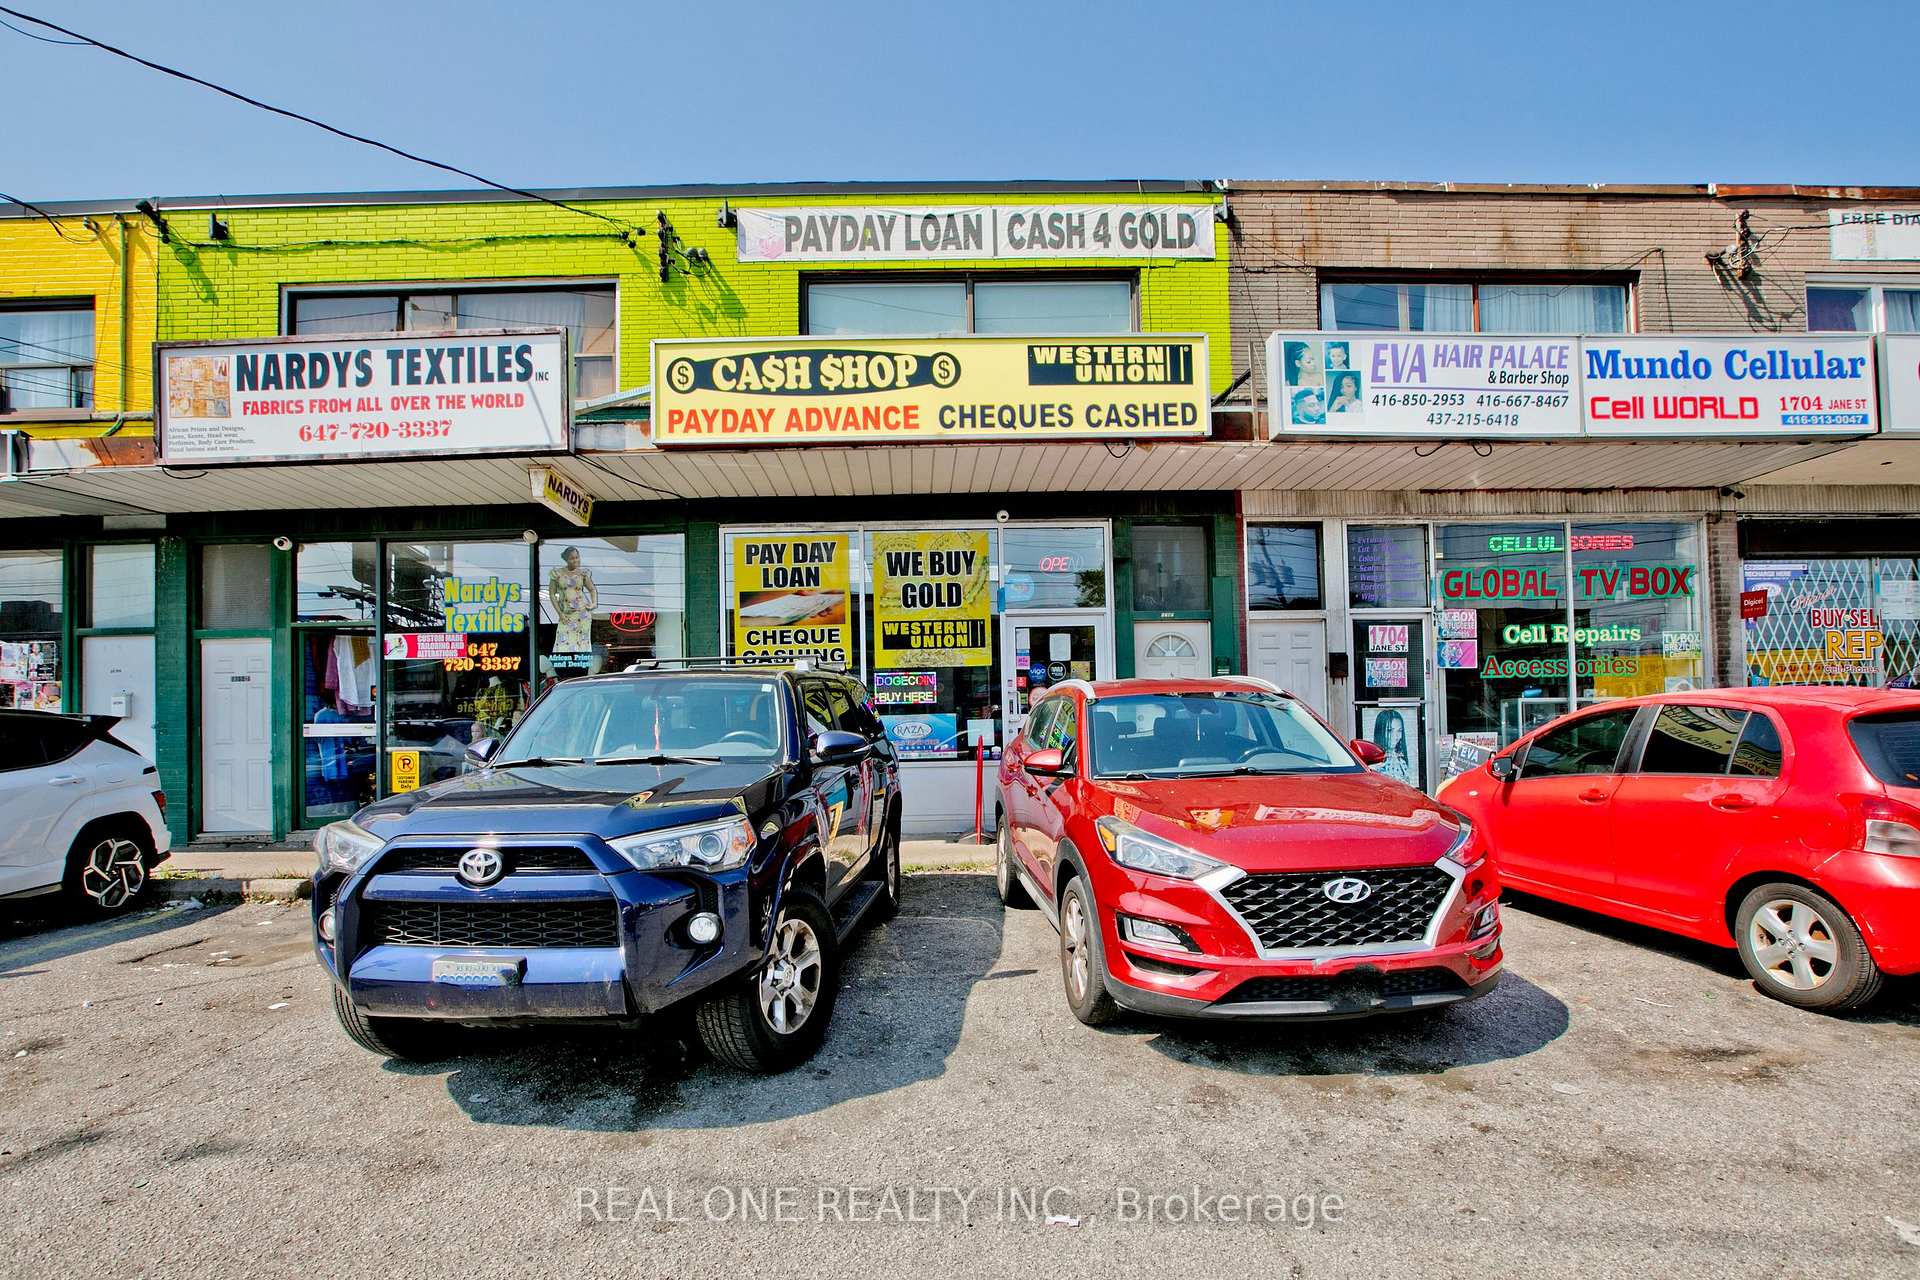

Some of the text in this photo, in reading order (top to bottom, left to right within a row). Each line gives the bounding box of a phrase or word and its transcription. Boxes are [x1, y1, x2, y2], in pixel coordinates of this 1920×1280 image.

[1841, 212, 1886, 225] FREE
[785, 212, 1197, 251] PAYDAY LOAN CASH 4 GOLD
[1033, 347, 1164, 364] WESTERN
[1371, 344, 1569, 383] EVA HAIR PALACE
[236, 344, 549, 391] NARDYS TEXTILES INC
[1075, 365, 1164, 382] UNION
[1586, 350, 1866, 380] Mundo Cellular
[1488, 371, 1569, 387] & Barber Shop
[243, 393, 525, 416] FABRICS FROM ALL OVER THE WORLD
[1372, 394, 1569, 407] 416-850-2953 416-667-8467
[1590, 396, 1867, 419] Cell WORLD 1704 JANE ST
[668, 403, 1198, 433] PAYDAY ADVANCE CHEQUES CASHED
[1426, 413, 1519, 426] 437-215-6418
[1786, 415, 1865, 425] 416-913-0047
[298, 419, 453, 442] 647-720-3337
[547, 474, 590, 514] NARDYS
[745, 541, 837, 565] PAY DAY
[886, 550, 976, 577] WE BUY
[762, 566, 821, 588] LOAN
[1443, 566, 1692, 598] GLOBAL TV BOX
[443, 576, 521, 608] Nardys
[902, 582, 962, 609] GOLD
[1743, 597, 1764, 607] Digicel
[444, 605, 525, 634] Textiles
[613, 610, 651, 625] OPEN
[1811, 608, 1882, 628] BUY SEL
[746, 628, 841, 645] CHEQUE
[884, 621, 968, 635] WESTERN
[1370, 627, 1407, 645] 1704
[1503, 624, 1642, 647] Cell Repairs
[467, 642, 498, 657] 647
[911, 635, 968, 648] UNION
[1371, 644, 1408, 652] JANE ST.
[443, 657, 522, 672] 720-3337
[1482, 656, 1640, 677] Accessories
[1845, 664, 1880, 674] Phones
[876, 676, 935, 686] DOGECOIN
[879, 691, 934, 702] BUY HERE
[896, 725, 925, 737] RAZA
[1460, 746, 1479, 762] EVA
